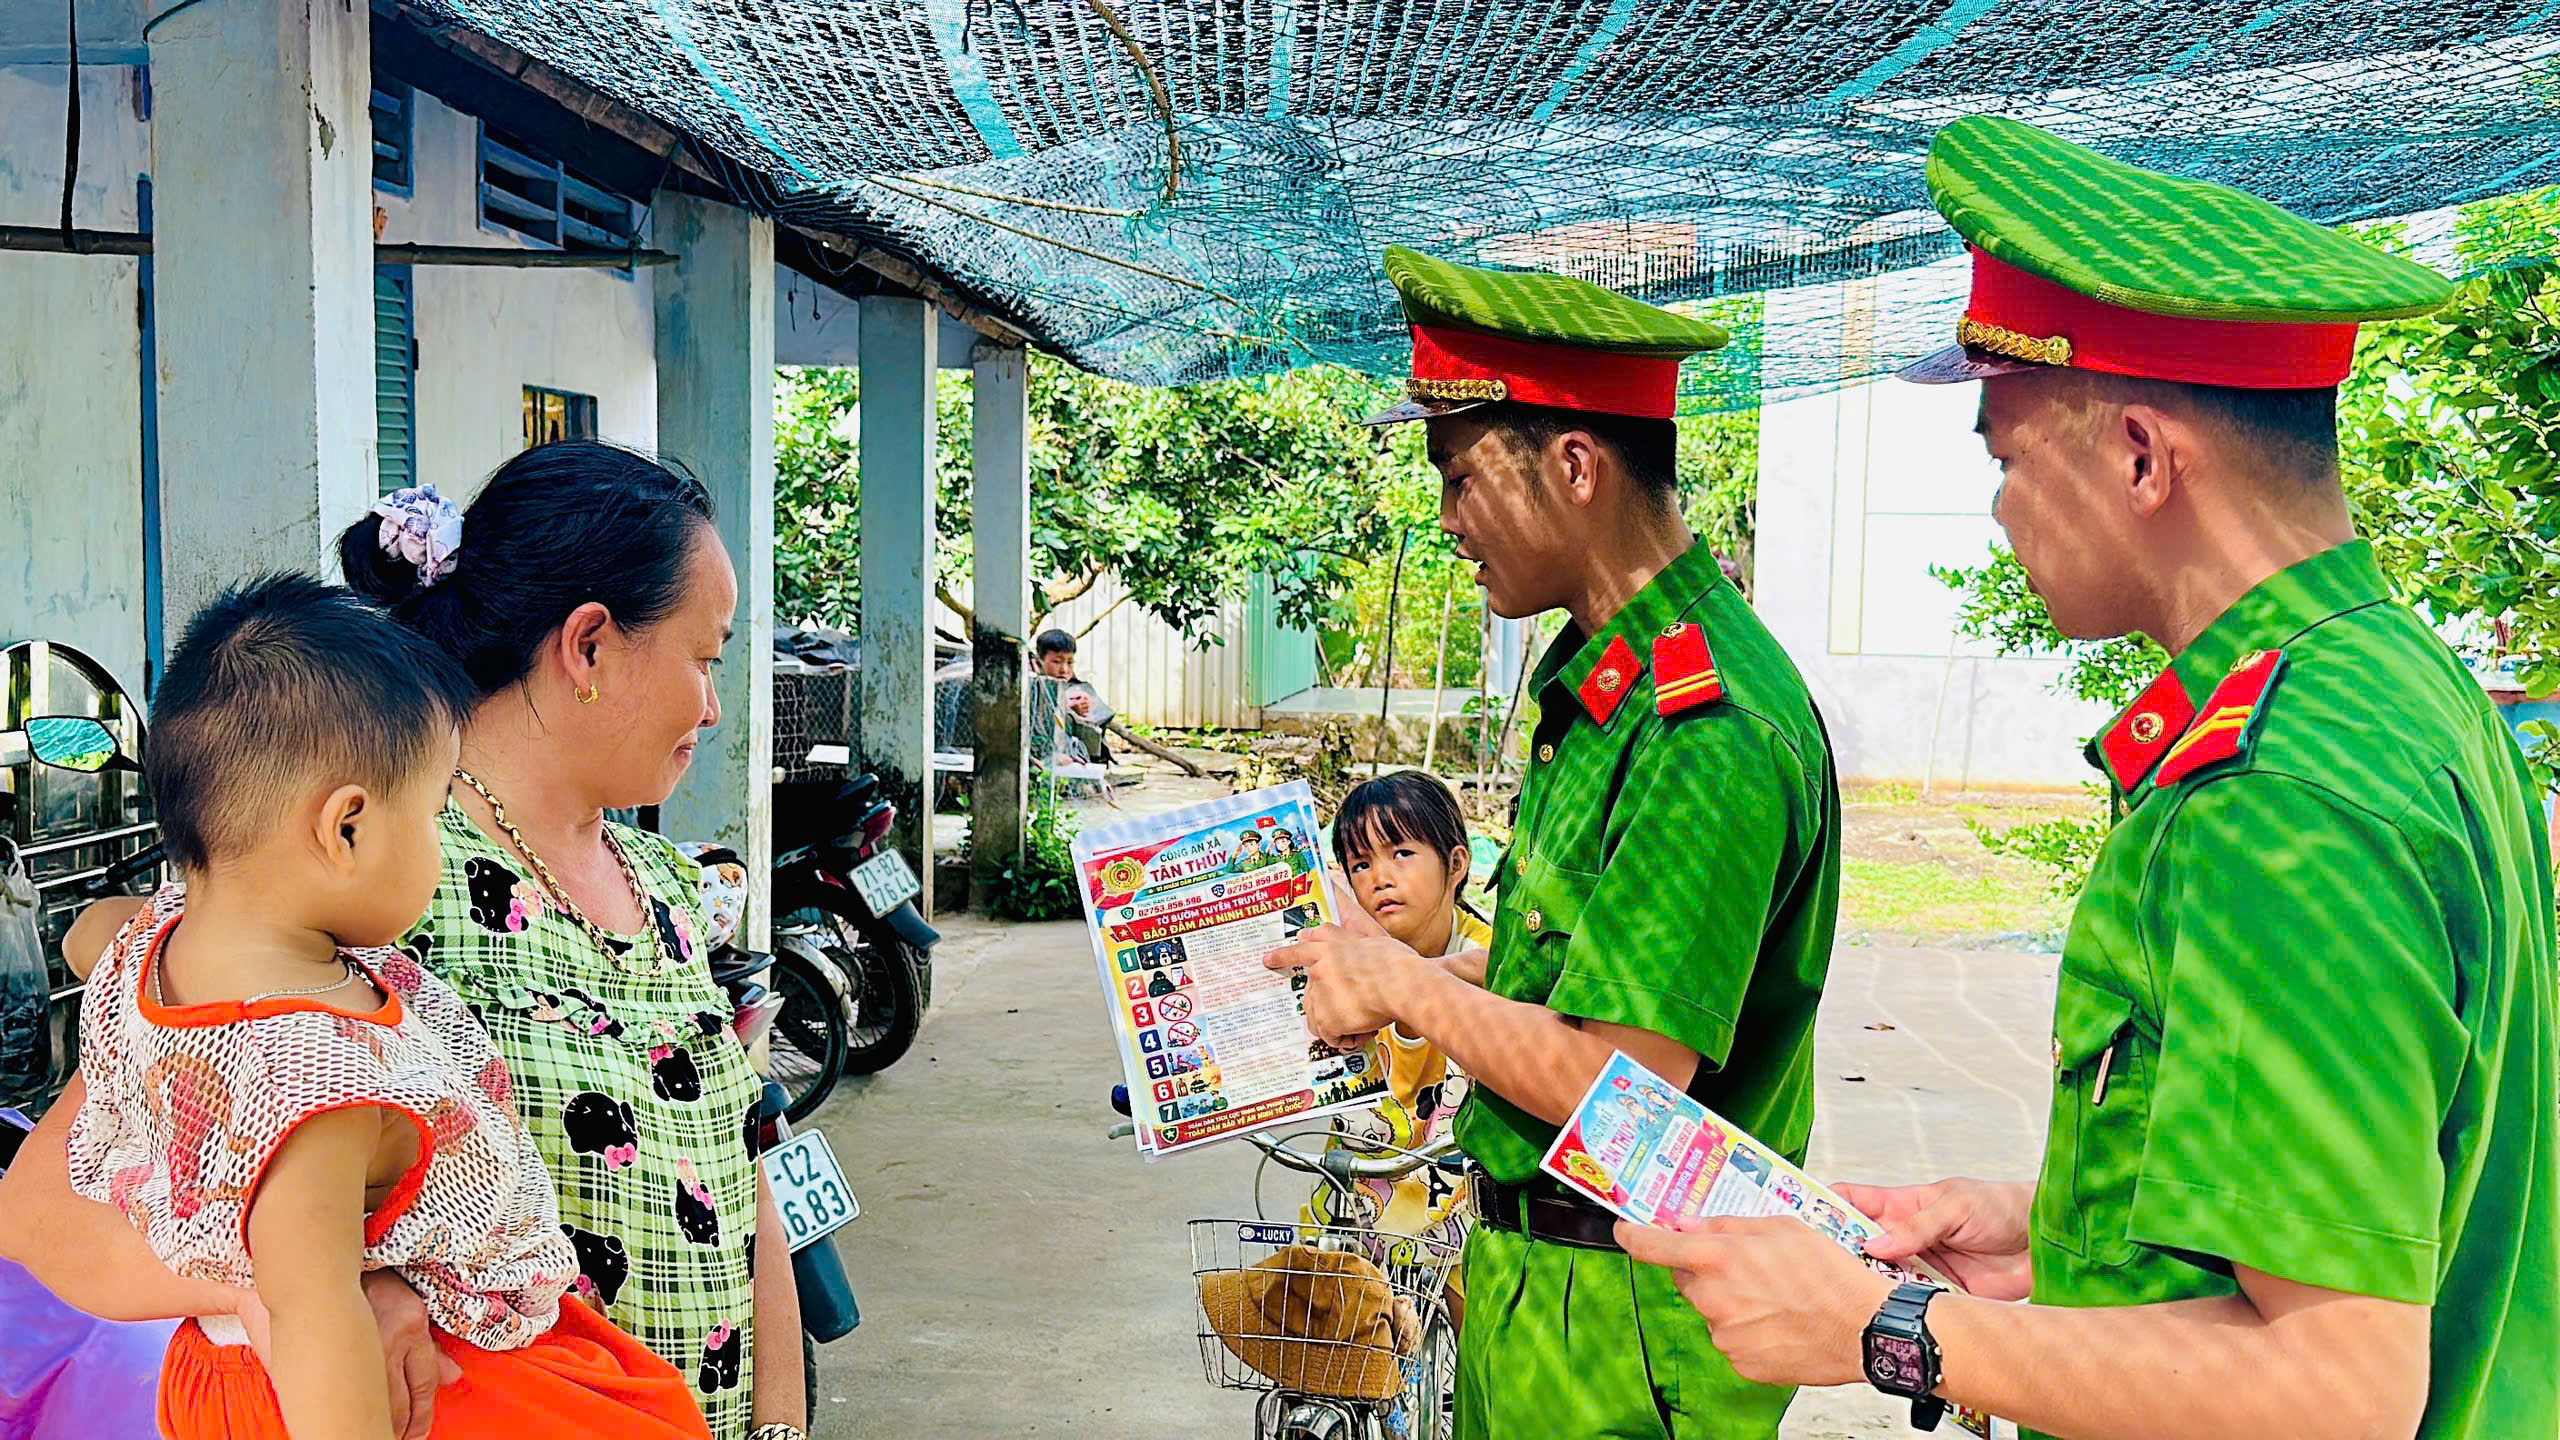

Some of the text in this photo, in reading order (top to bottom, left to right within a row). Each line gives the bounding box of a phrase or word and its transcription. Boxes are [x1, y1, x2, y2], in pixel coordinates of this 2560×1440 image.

[1158, 837, 1221, 862] CÔNG AN XÃ
[857, 853, 900, 888] 71-B2
[1149, 849, 1229, 883] TÂN THỦY
[1200, 900, 1231, 915] TUYÊN
[1231, 889, 1268, 907] TRUYỀN
[1141, 892, 1292, 940] BẢO ĐẢM AN NINH TRẬT TỰ
[1122, 952, 1133, 968] 1
[1129, 980, 1143, 995] 2
[1136, 1006, 1150, 1023] 3
[1144, 1033, 1157, 1049] 4
[1150, 1059, 1163, 1075] 5
[1157, 1084, 1169, 1099] 6
[1163, 1104, 1173, 1121] 7
[1608, 1118, 1639, 1151] THỦY
[1598, 1144, 1624, 1169] TÂN
[783, 1180, 846, 1243] 6.83
[1262, 1229, 1291, 1241] LUCKY
